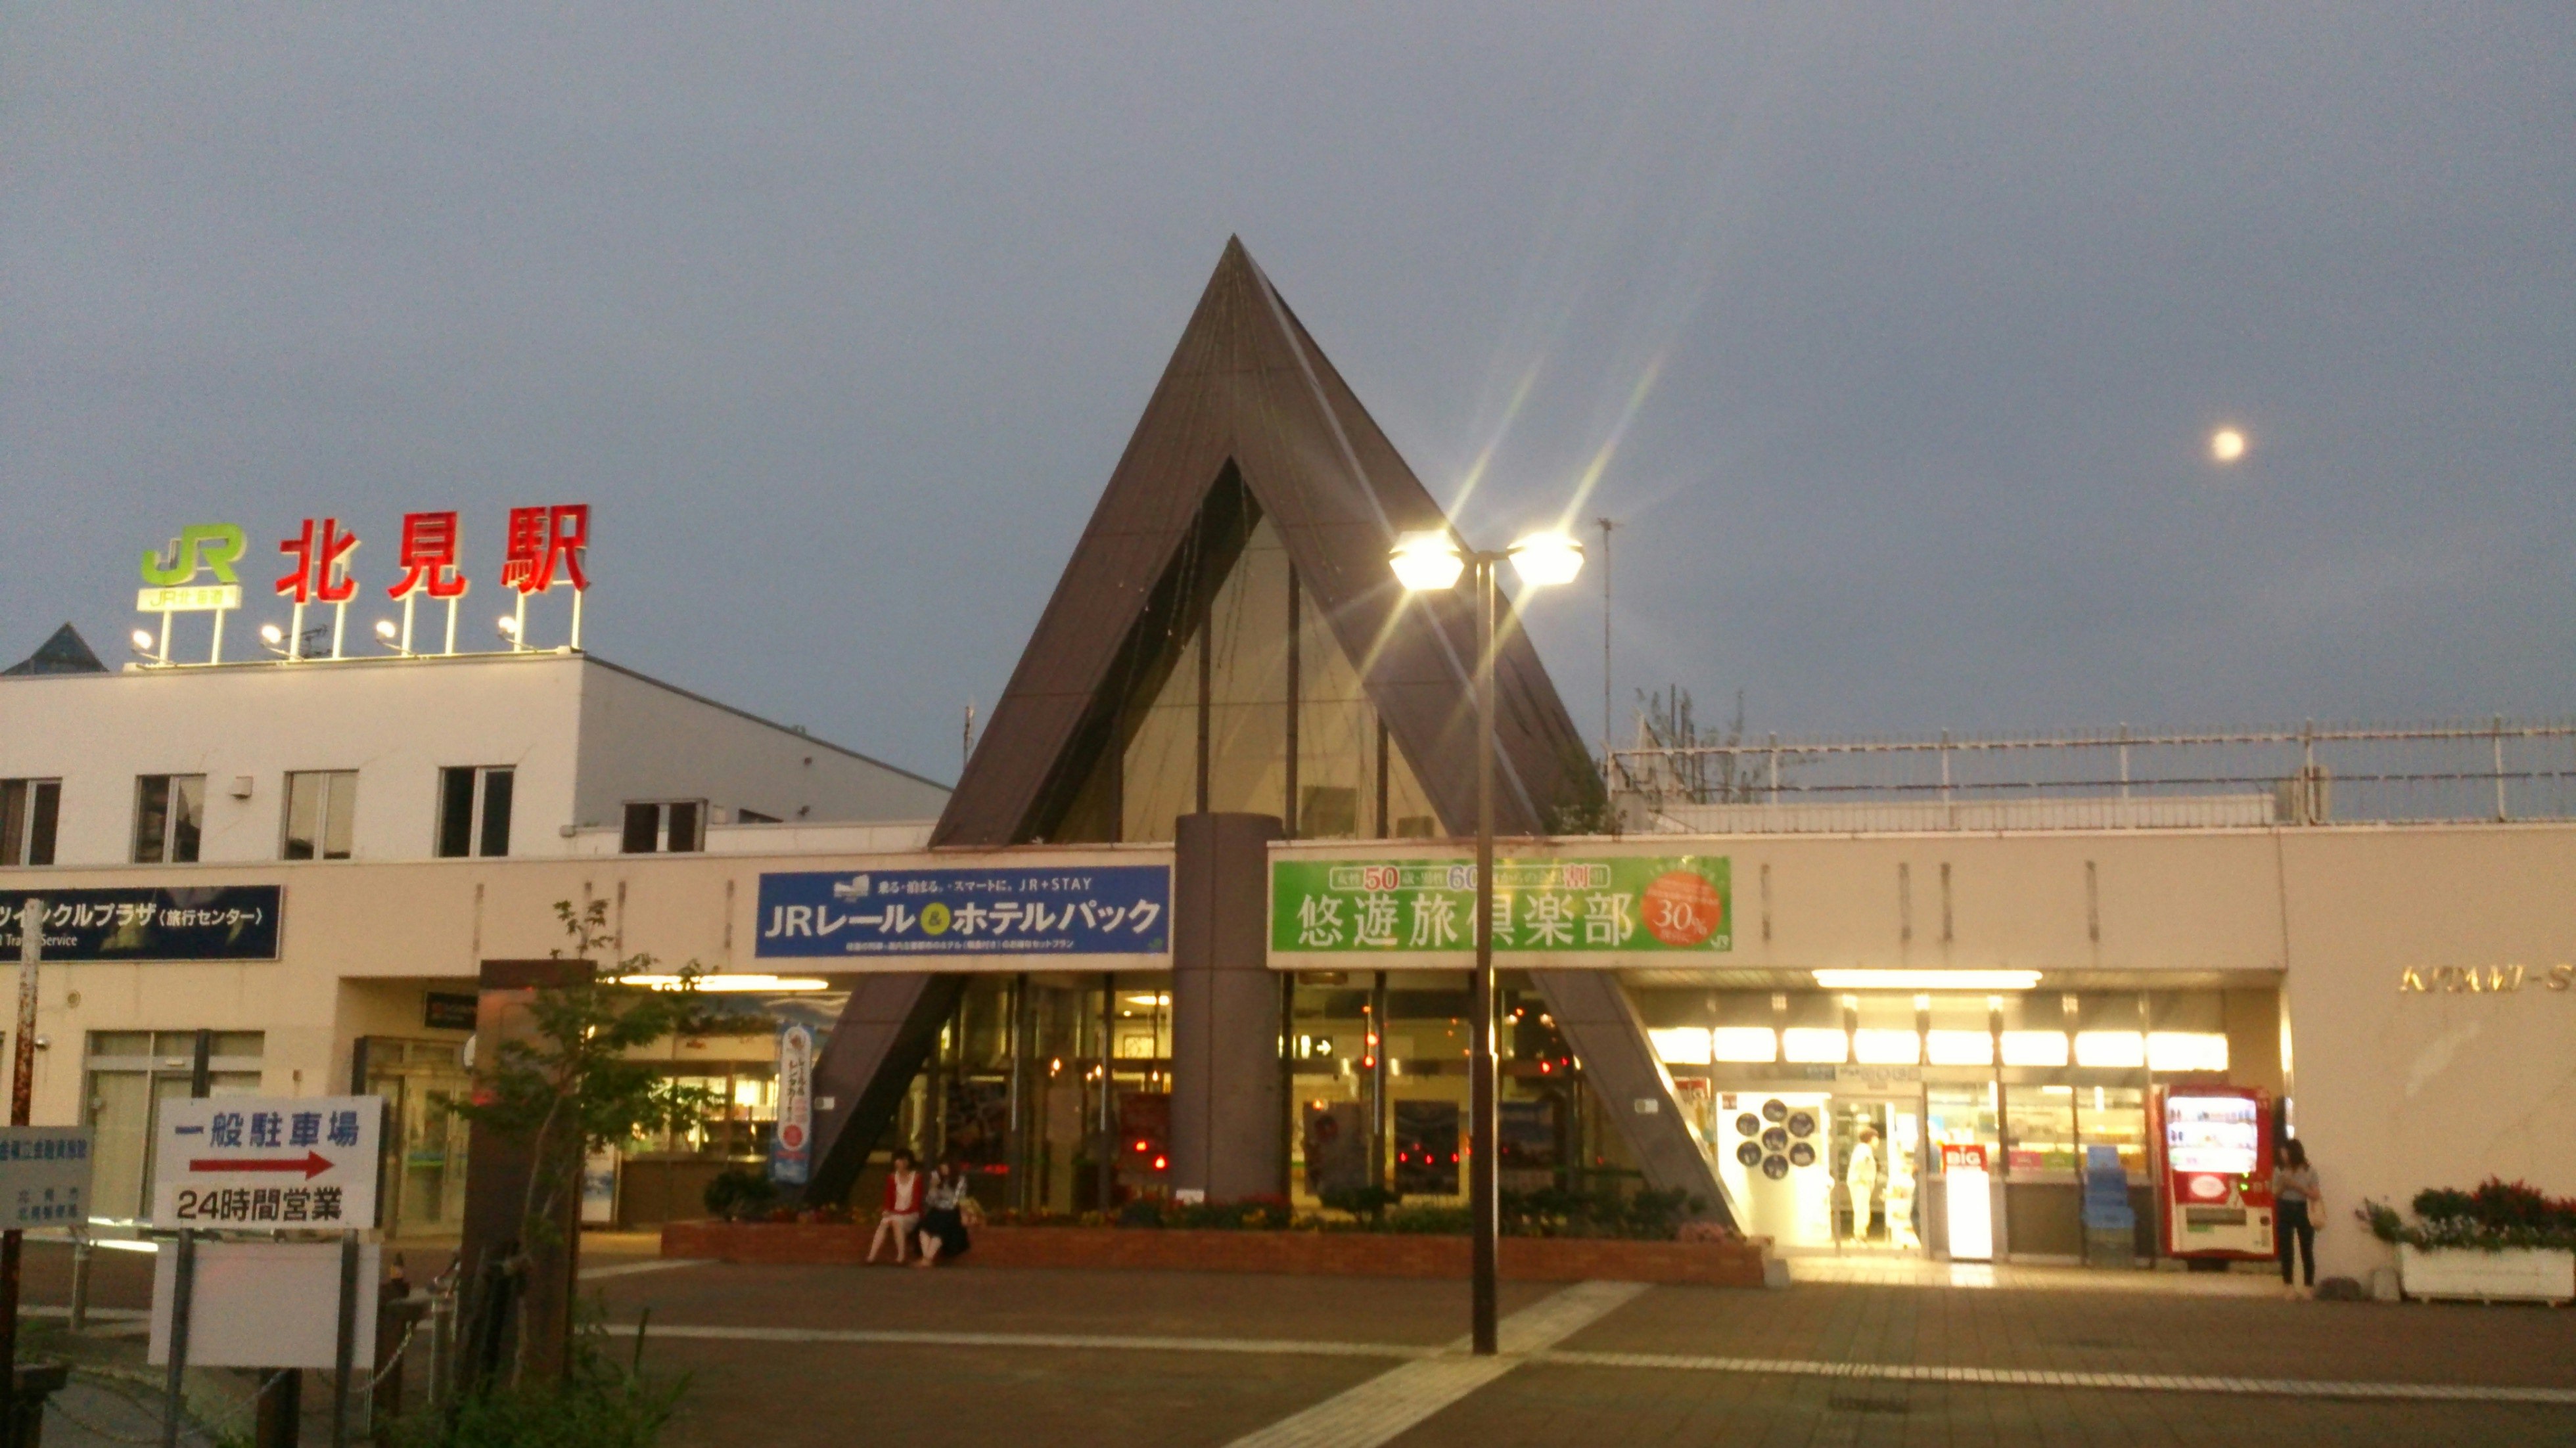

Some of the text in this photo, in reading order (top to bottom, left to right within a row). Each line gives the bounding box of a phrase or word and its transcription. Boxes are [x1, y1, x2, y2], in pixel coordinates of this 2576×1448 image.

[140, 523, 246, 587] JR
[275, 504, 588, 604] 北見駅
[41, 934, 78, 946] Service
[2400, 964, 2576, 993] KITAMI-S
[174, 1110, 359, 1148] 一般駐車場
[177, 1186, 343, 1222] 24時間営業
